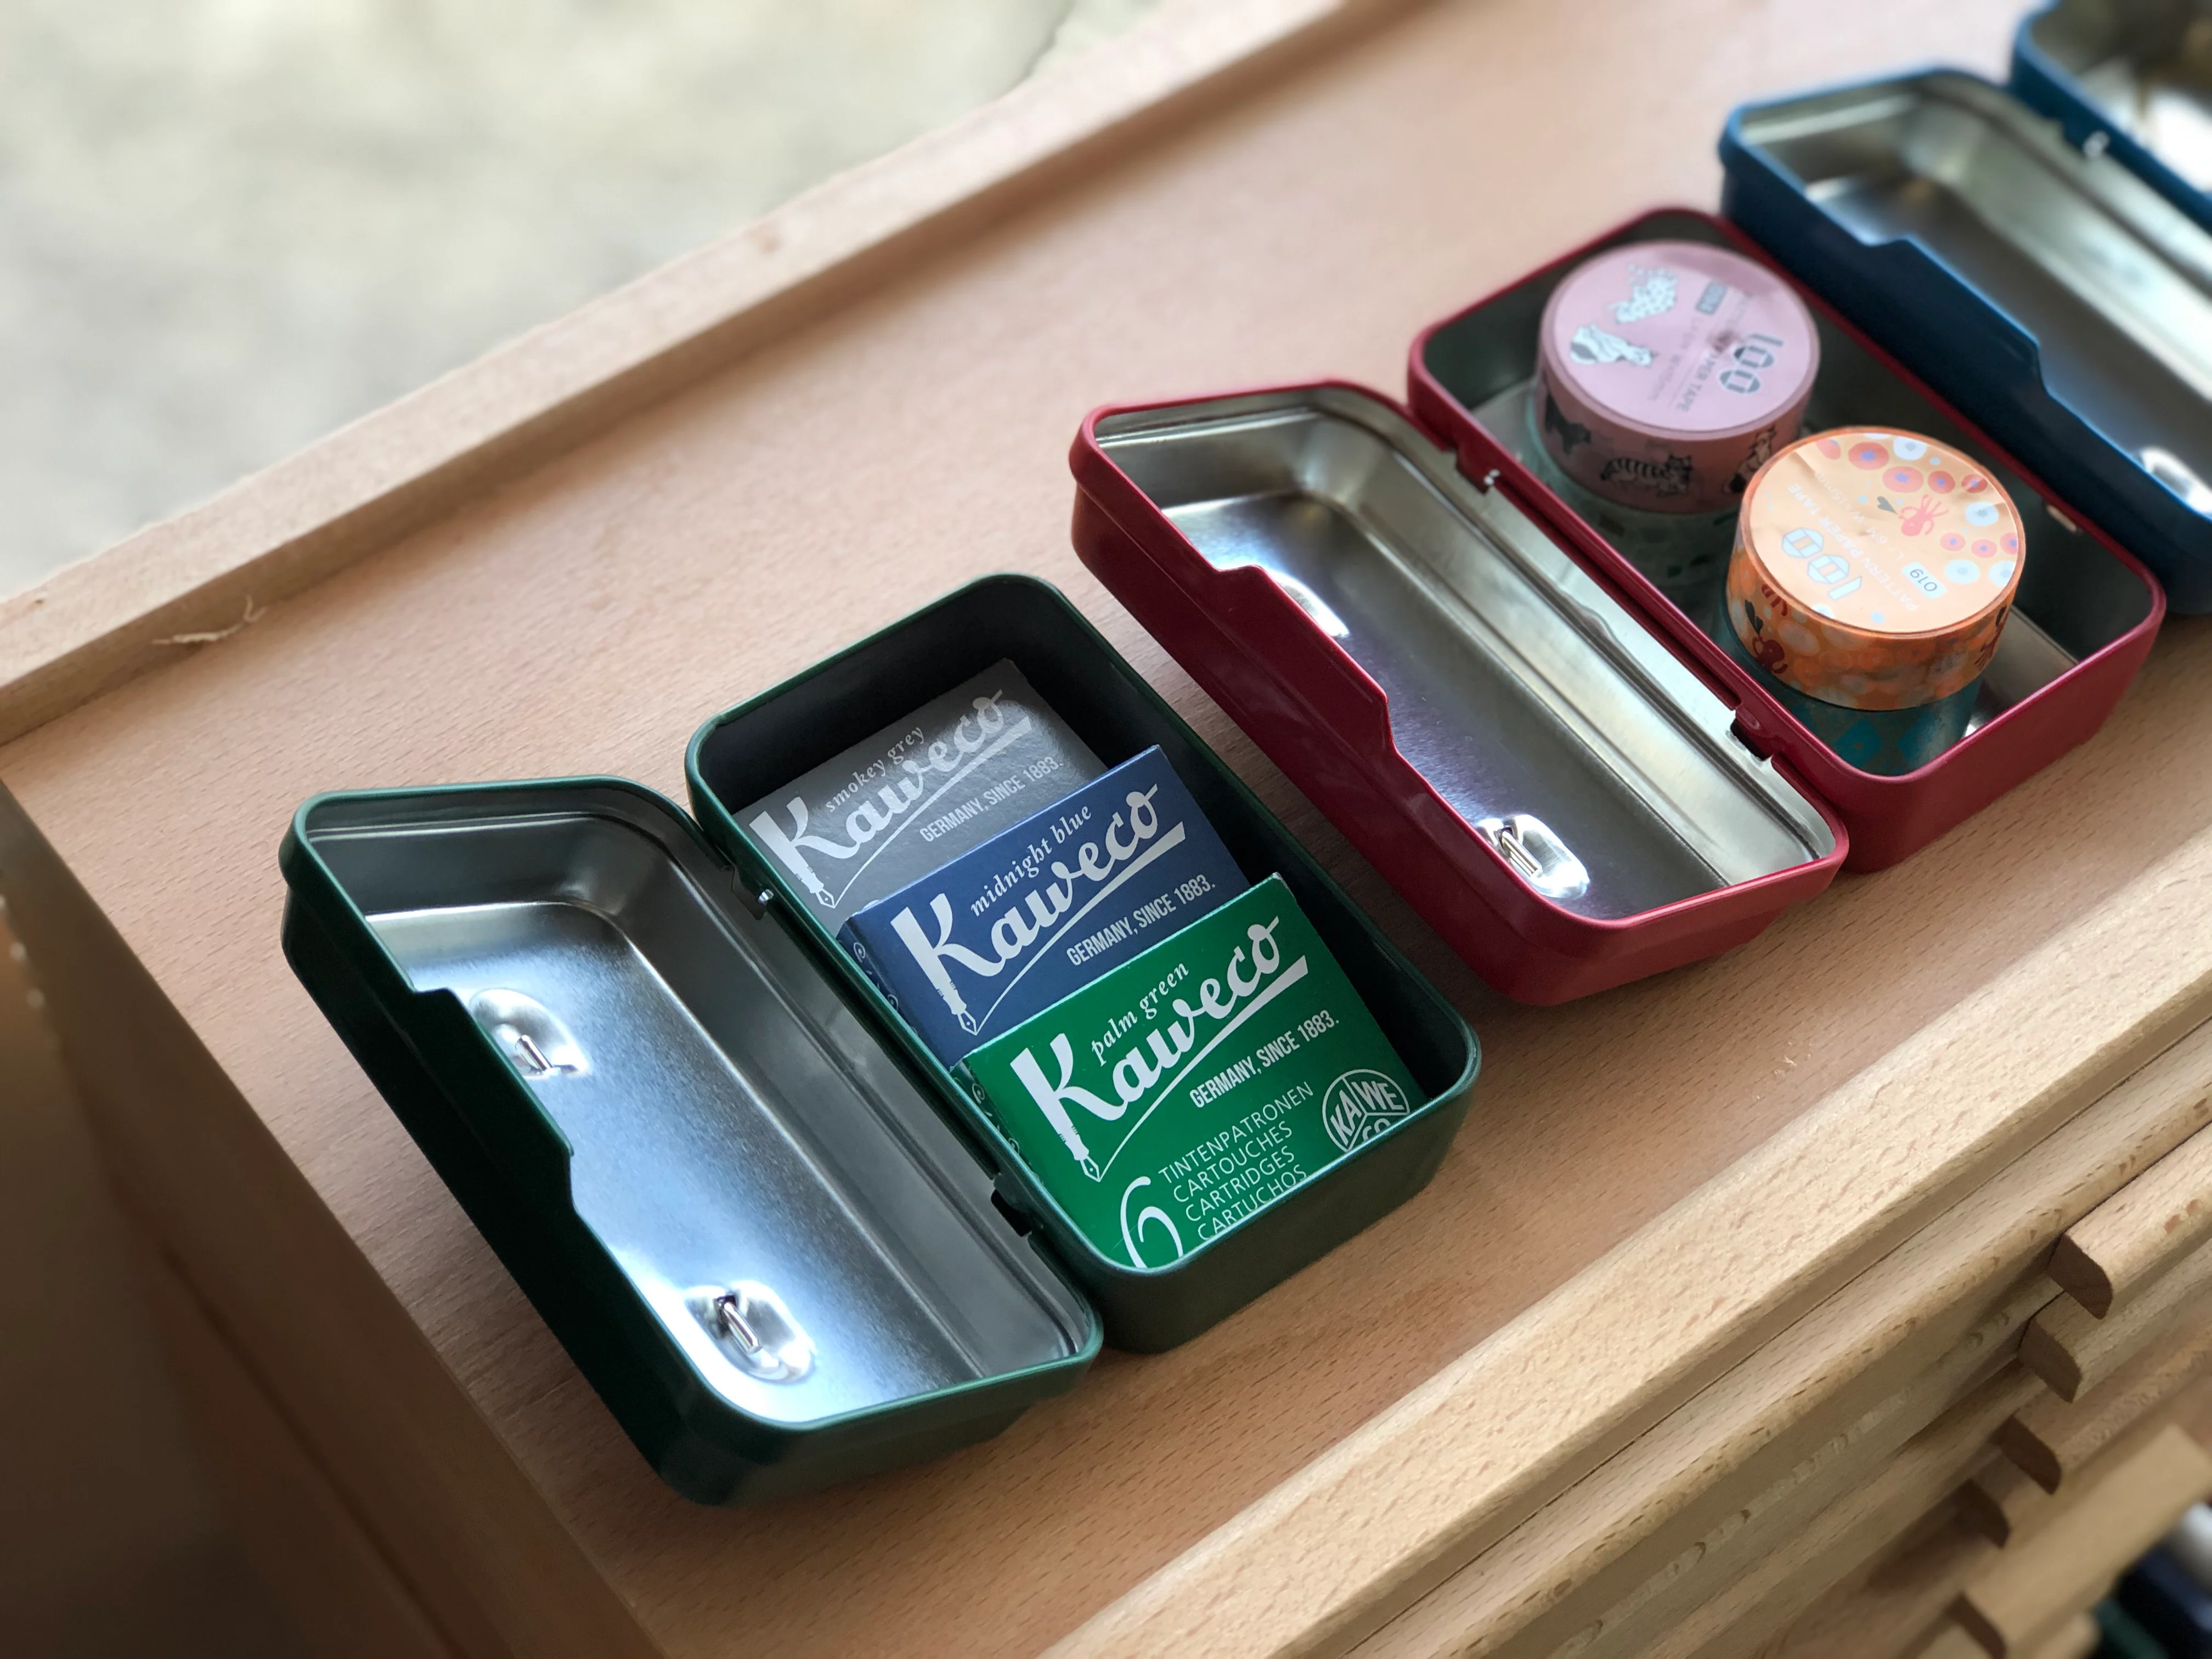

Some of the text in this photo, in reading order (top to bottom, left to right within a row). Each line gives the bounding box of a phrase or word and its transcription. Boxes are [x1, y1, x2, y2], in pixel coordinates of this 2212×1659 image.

[1719, 334, 1784, 394] 100
[1781, 527, 1863, 601] 100
[1787, 483, 1918, 611] PATTERN PAPER TAPE
[1910, 568, 1938, 592] 019
[749, 690, 1003, 909] Kaweco
[826, 726, 924, 812] smokey grey
[919, 755, 1064, 843] GERMANY, SINCE 1883.
[970, 805, 1092, 917] midnight blue
[890, 783, 1158, 1036] Kaweco
[1066, 873, 1216, 967] GERMANY, SINCE 1883.
[1010, 916, 1279, 1182] Kaweco
[1090, 963, 1189, 1066] palm green
[1189, 1009, 1340, 1109] GERMANY, SINCE 1883.
[1158, 1081, 1313, 1183] TINTENPATRONEN
[1173, 1121, 1292, 1202] CARTOUCHES
[1120, 1176, 1183, 1268] 6
[1186, 1146, 1295, 1221] CARTRIDGES
[1198, 1164, 1307, 1240] CARTUCHOS
